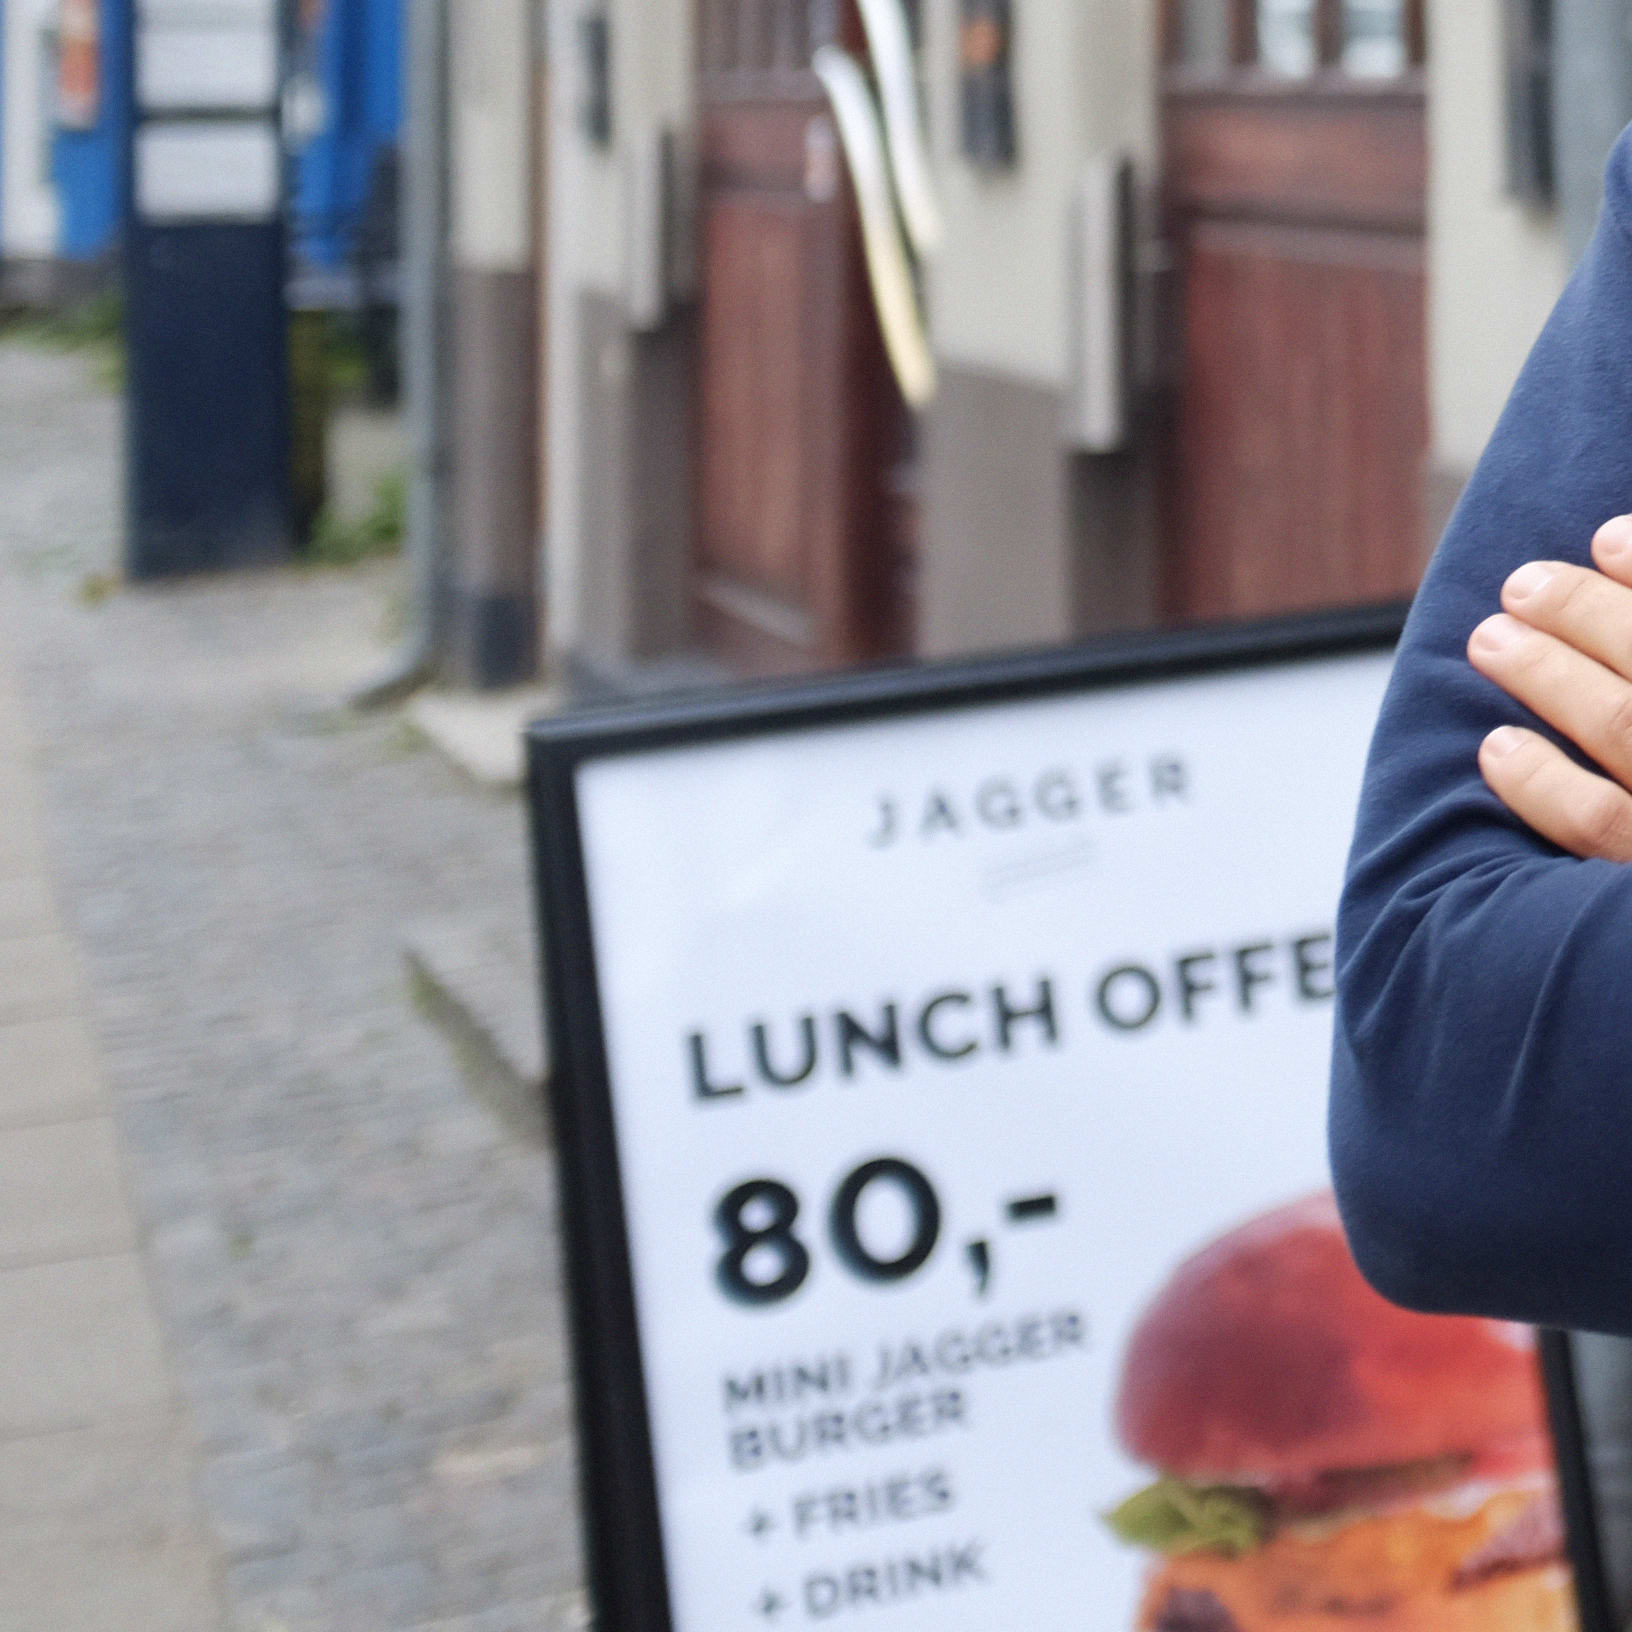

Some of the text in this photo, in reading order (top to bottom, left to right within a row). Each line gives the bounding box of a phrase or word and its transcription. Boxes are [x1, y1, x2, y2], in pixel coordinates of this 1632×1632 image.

[867, 749, 1196, 850] JAGGER
[686, 928, 1337, 1104] LUNCH OFFE
[710, 1154, 1060, 1310] 80,-
[724, 1310, 1087, 1411] MINI JAGGER
[729, 1386, 968, 1472] BURGER
[793, 1465, 956, 1539] FRIES
[802, 1537, 988, 1621] DRINK
